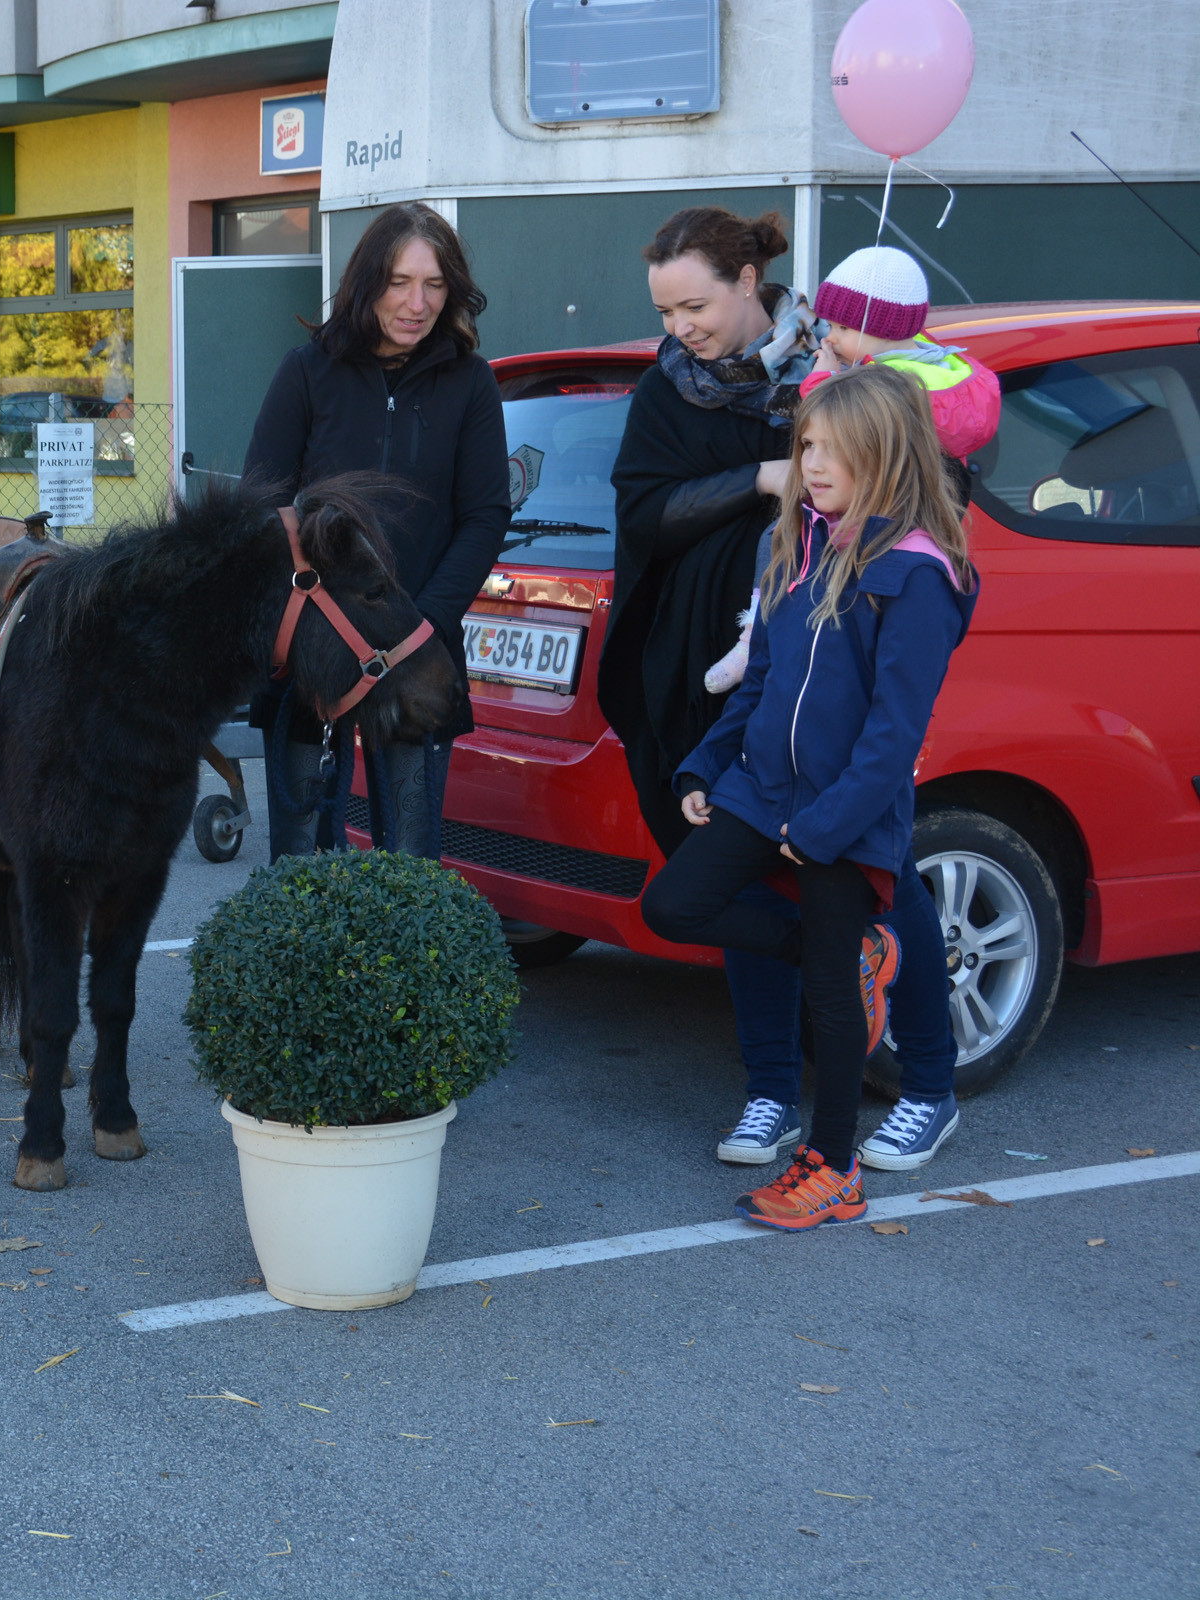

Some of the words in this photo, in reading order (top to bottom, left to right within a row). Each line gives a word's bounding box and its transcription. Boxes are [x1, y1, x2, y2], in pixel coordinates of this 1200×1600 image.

[277, 121, 300, 147] Stiegl
[346, 130, 402, 171] Rapid
[40, 441, 84, 452] PRIVAT
[492, 629, 533, 670] 354
